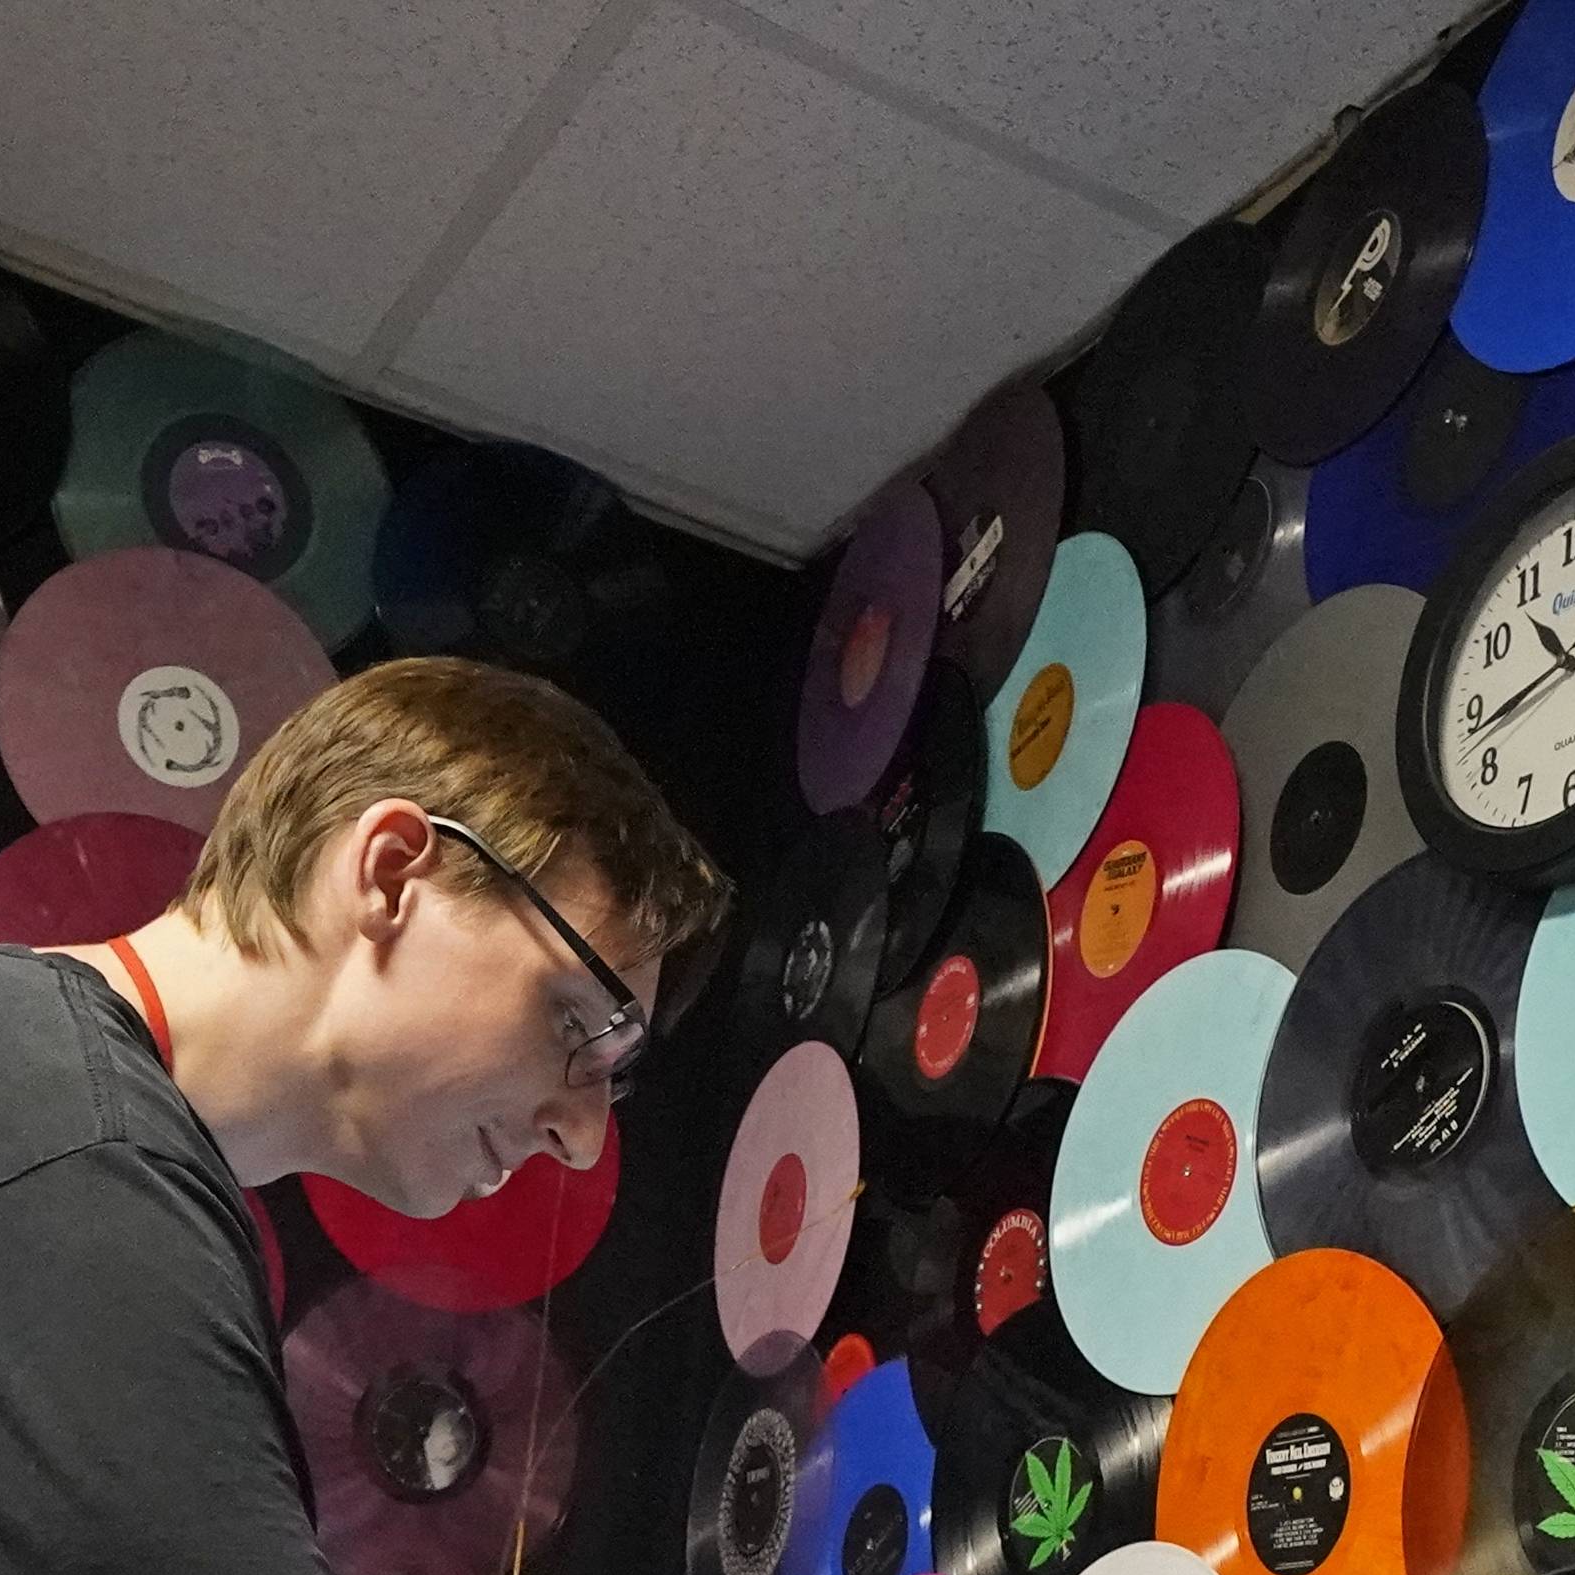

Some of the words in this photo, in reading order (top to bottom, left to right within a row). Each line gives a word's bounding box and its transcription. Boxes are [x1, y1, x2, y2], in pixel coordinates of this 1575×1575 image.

[1516, 561, 1542, 609] 11
[1482, 621, 1512, 670] 10
[1466, 693, 1485, 735] 9
[1480, 746, 1500, 787] 8
[1516, 772, 1534, 816] 7
[983, 1214, 1038, 1259] COLUMBIA
